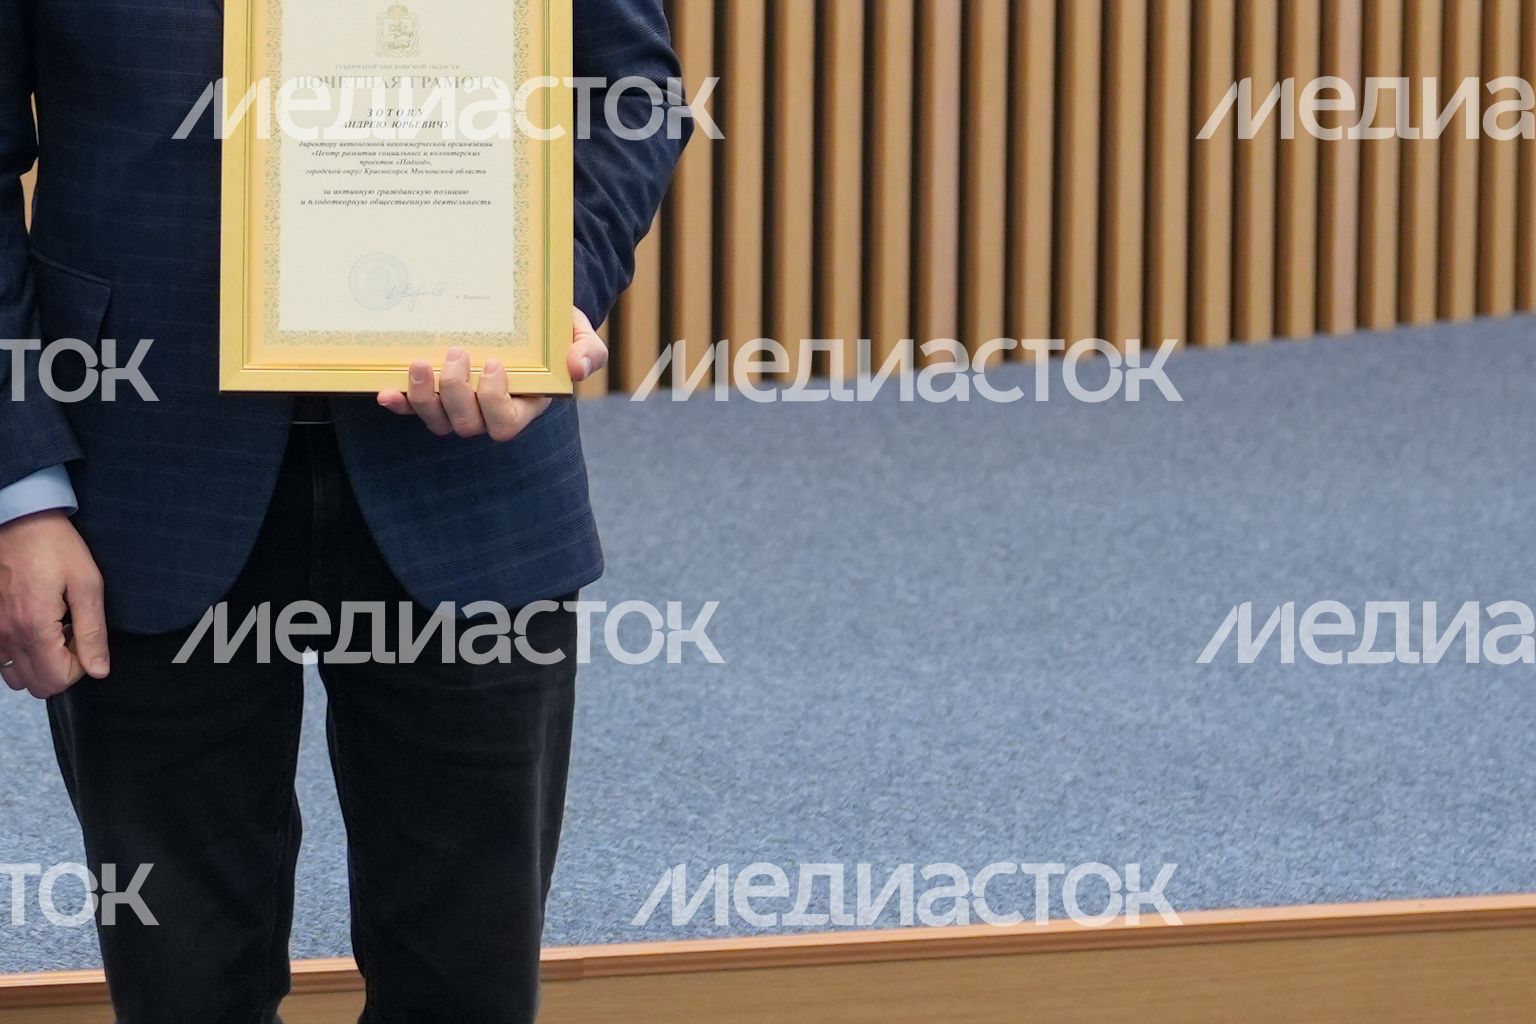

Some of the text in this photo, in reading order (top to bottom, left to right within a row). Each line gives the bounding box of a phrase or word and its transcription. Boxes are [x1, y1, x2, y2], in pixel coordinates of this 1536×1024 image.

[407, 75, 501, 89] ГРАМОТА
[341, 120, 450, 129] АНДРЕЮ ЮРЬЕВИЧУ
